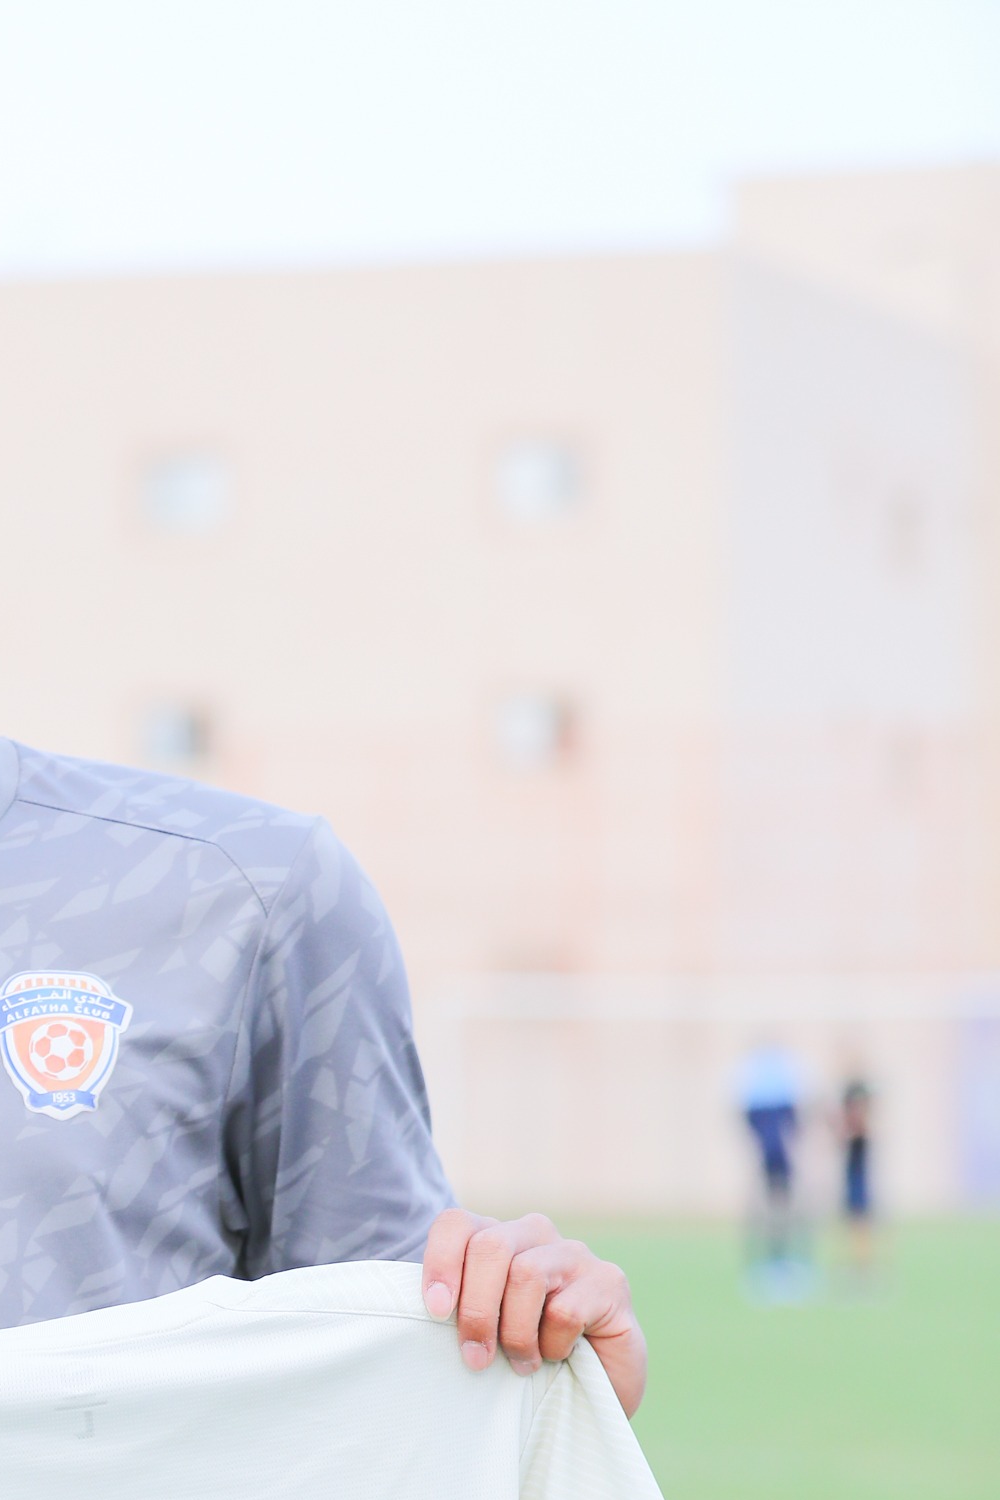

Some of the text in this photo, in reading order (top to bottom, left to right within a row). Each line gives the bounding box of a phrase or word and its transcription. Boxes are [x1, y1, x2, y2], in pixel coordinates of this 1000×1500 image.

[6, 1003, 111, 1024] ALFAYHA CLUB
[52, 1092, 76, 1103] 1953
